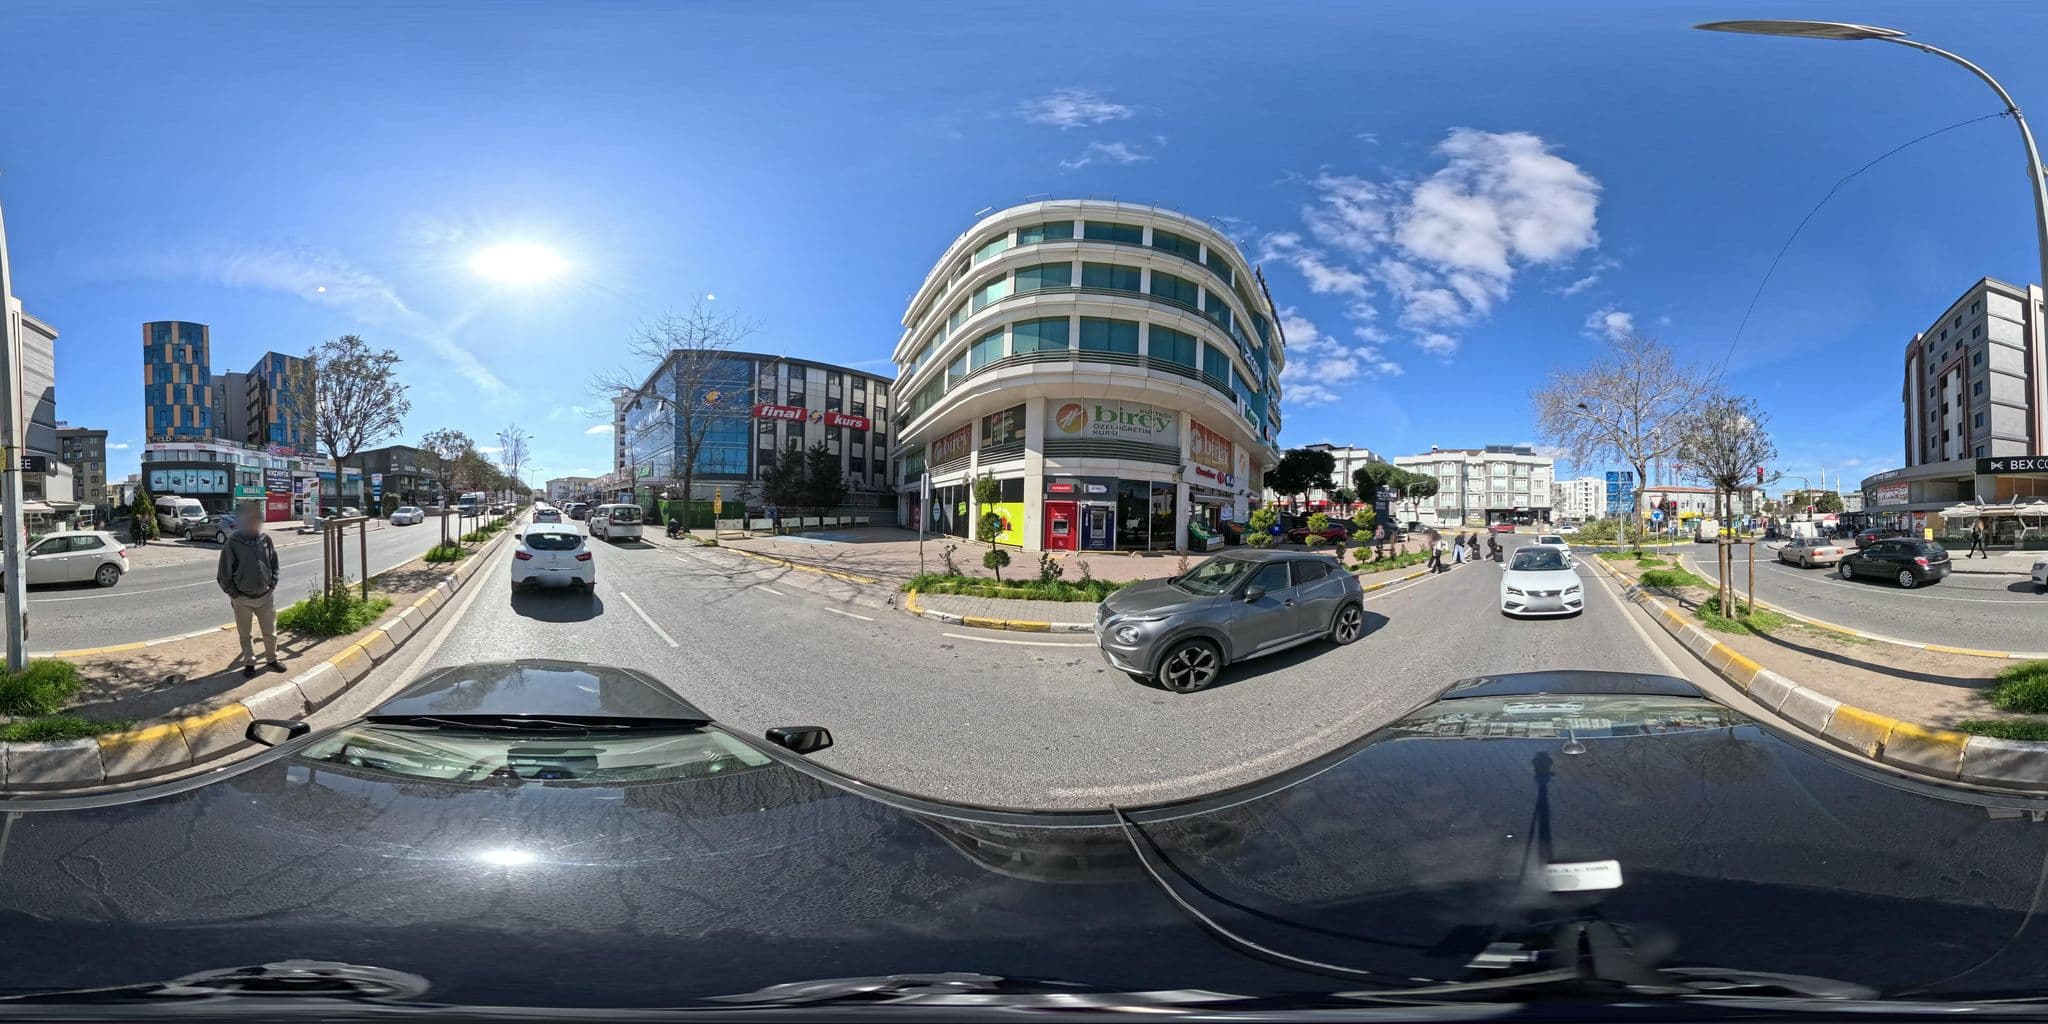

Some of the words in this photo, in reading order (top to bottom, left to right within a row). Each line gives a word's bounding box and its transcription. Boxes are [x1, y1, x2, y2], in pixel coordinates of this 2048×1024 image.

[761, 406, 801, 419] final
[1095, 405, 1170, 432] birey
[834, 414, 863, 428] kurs
[2010, 460, 2034, 470] BEX
